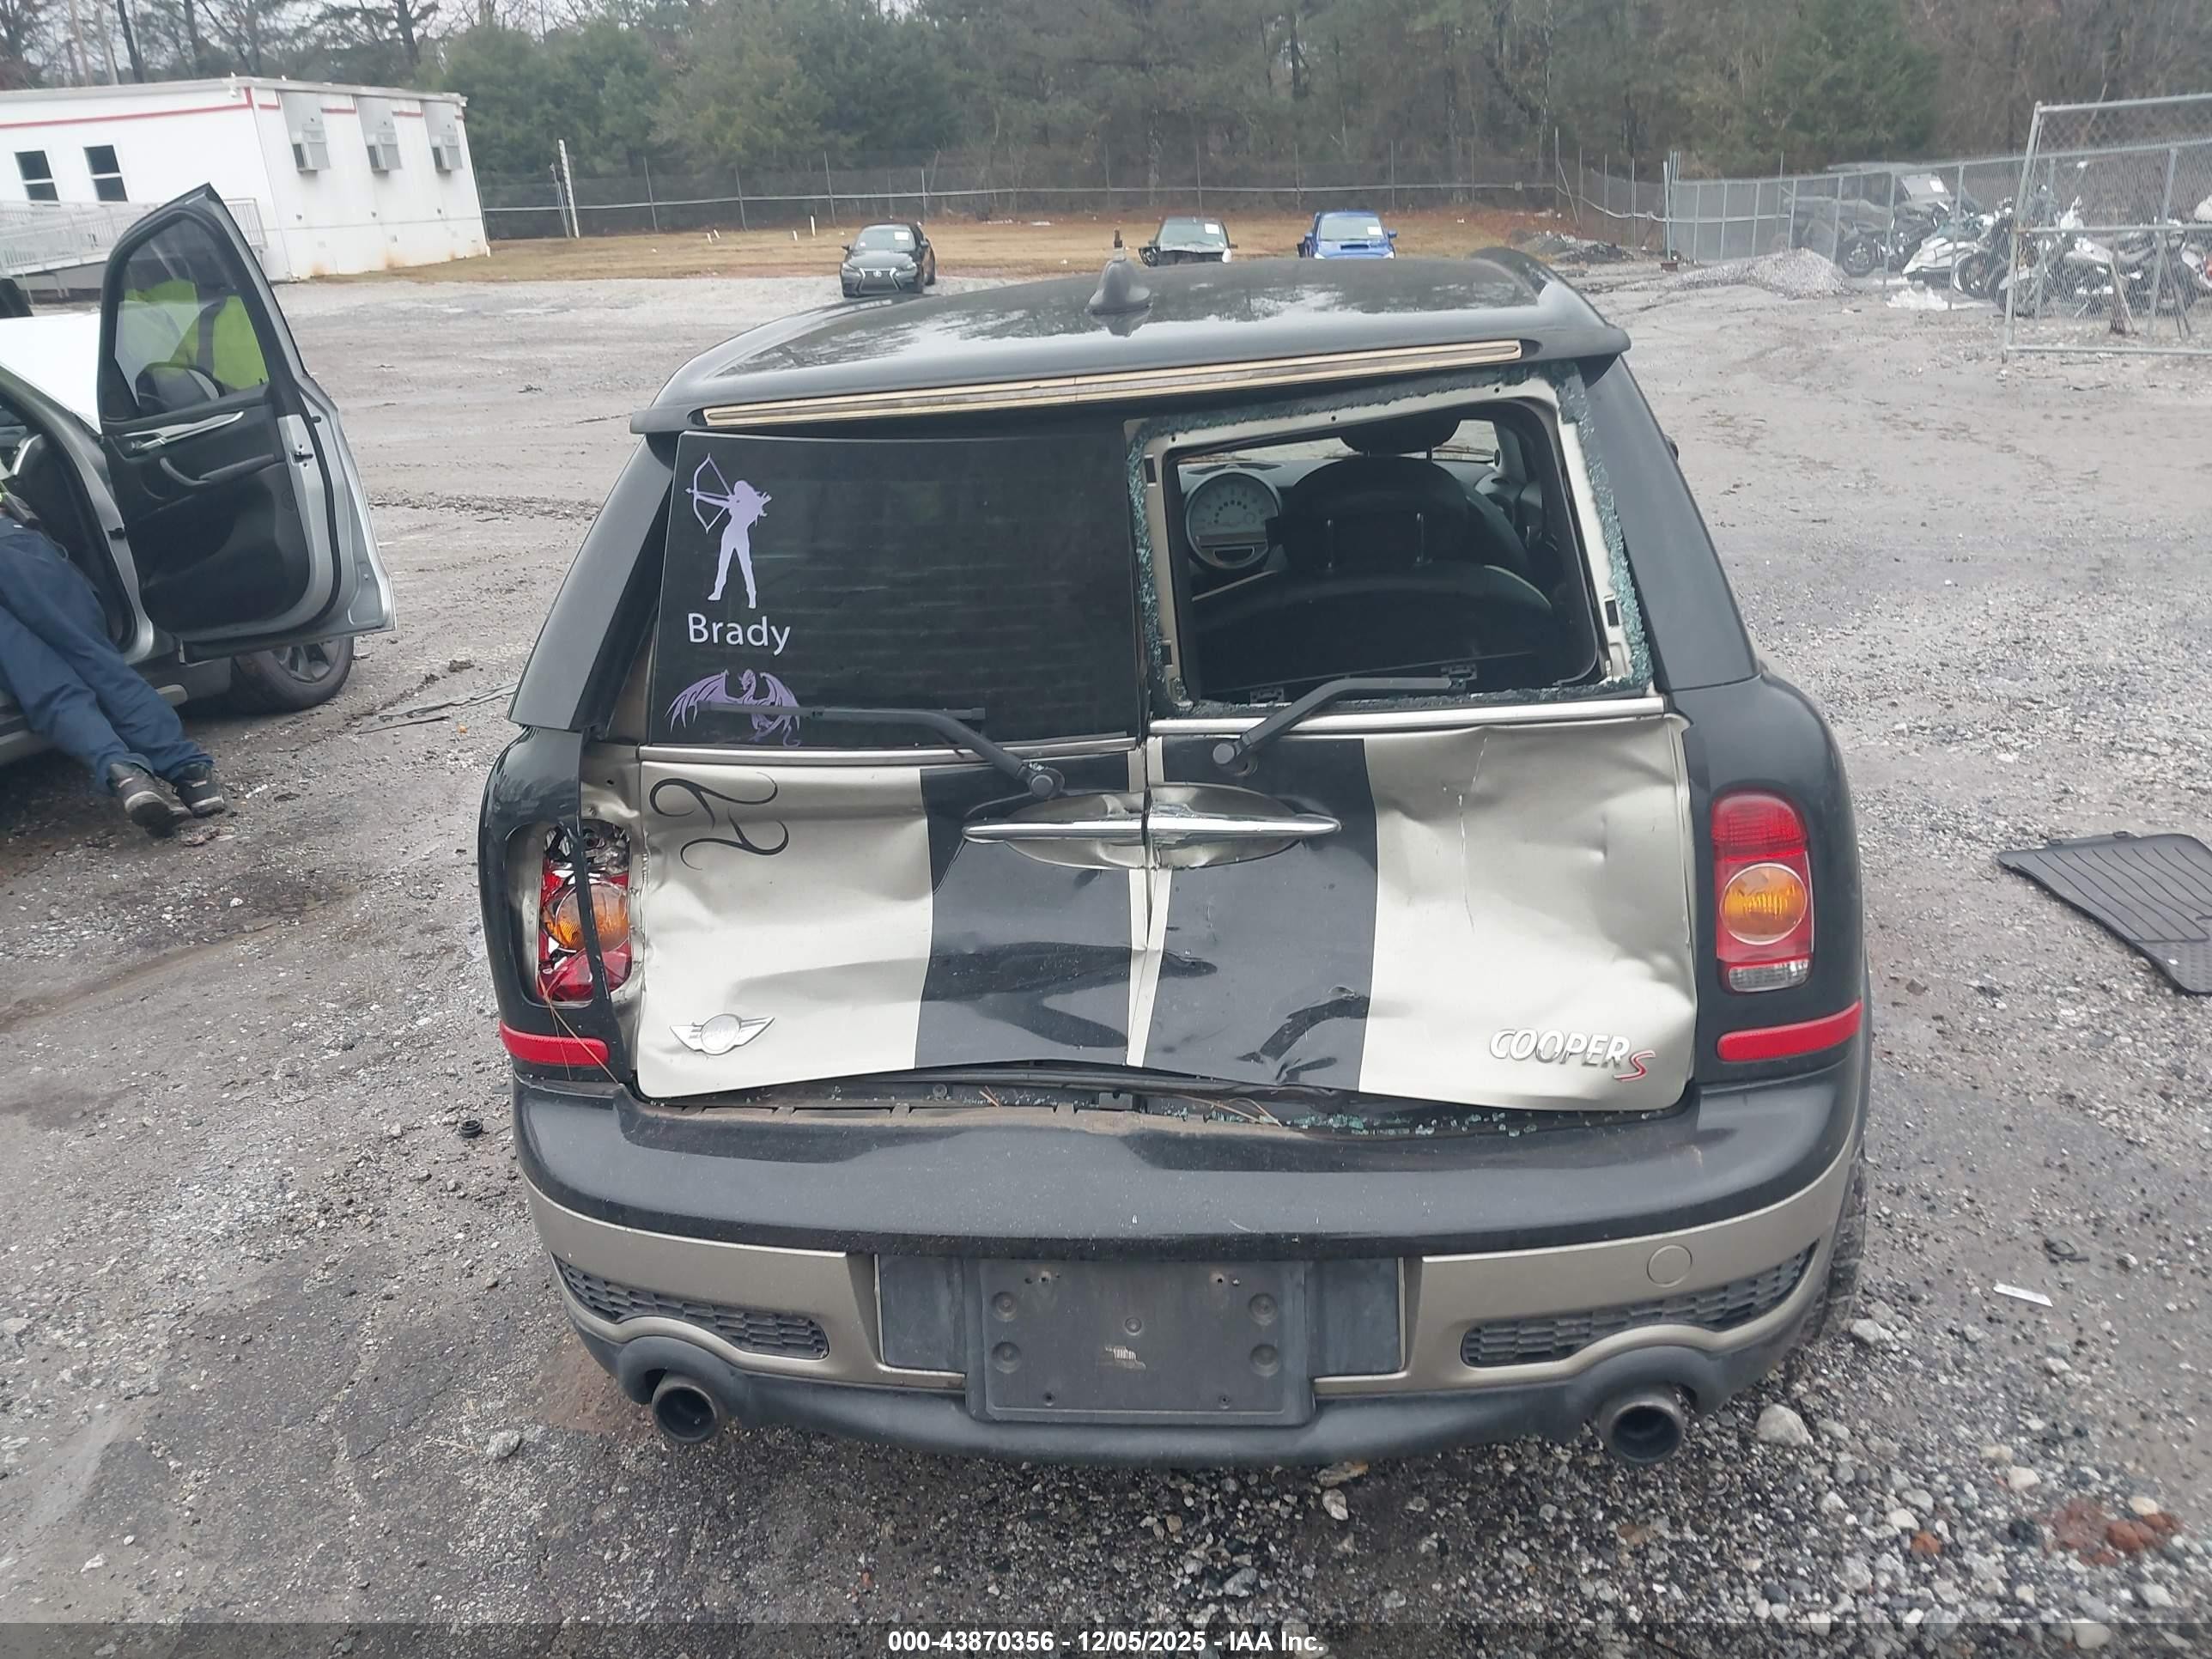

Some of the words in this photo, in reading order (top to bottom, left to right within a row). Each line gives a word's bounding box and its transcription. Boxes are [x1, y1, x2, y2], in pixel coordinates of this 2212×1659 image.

[687, 612, 791, 656] Brady
[1489, 1028, 1631, 1069] COOPER
[1613, 1049, 1656, 1082] S
